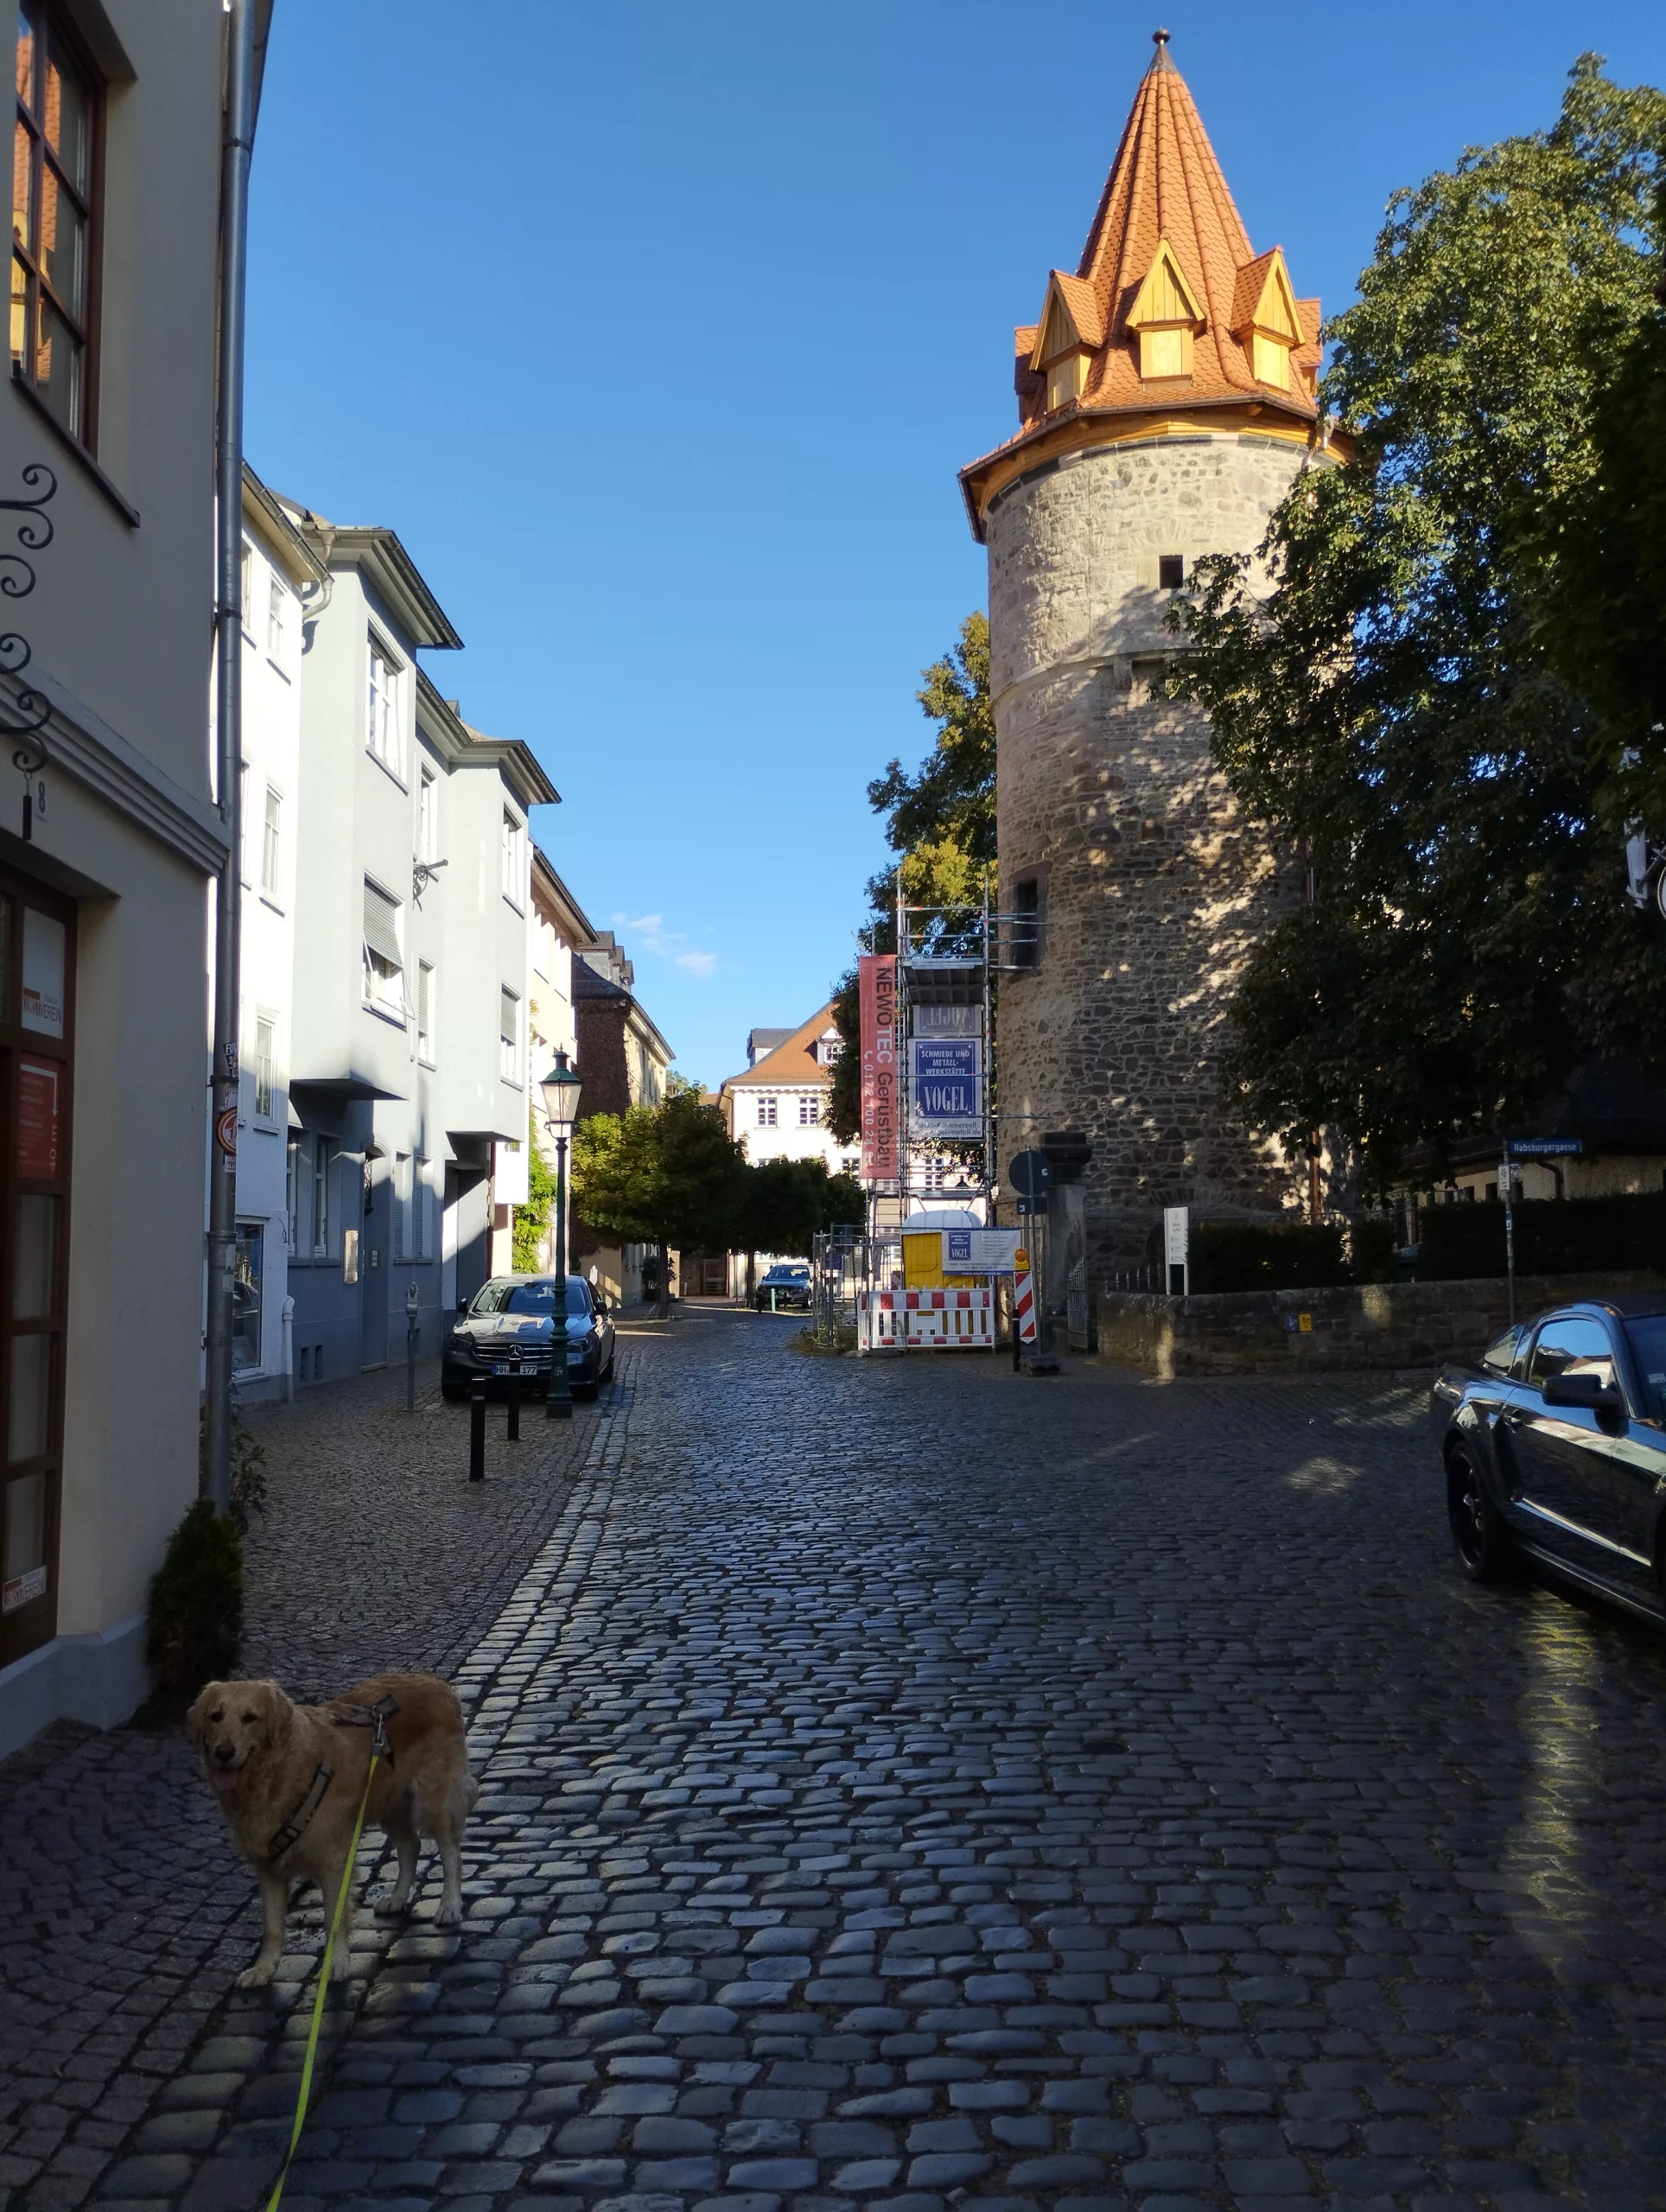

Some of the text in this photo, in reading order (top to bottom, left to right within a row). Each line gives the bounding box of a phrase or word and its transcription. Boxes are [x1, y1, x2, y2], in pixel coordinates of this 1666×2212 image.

[38, 781, 46, 813] 8
[876, 967, 893, 1167] NEWOTEC Gerüstbau
[925, 1066, 966, 1075] WERKSTÄTTE
[932, 1058, 958, 1067] METALL-
[864, 1065, 874, 1096] 0172
[923, 1085, 968, 1112] VOGEL
[1514, 1143, 1577, 1154] Habsburgergasse
[951, 1249, 968, 1258] VOGEL
